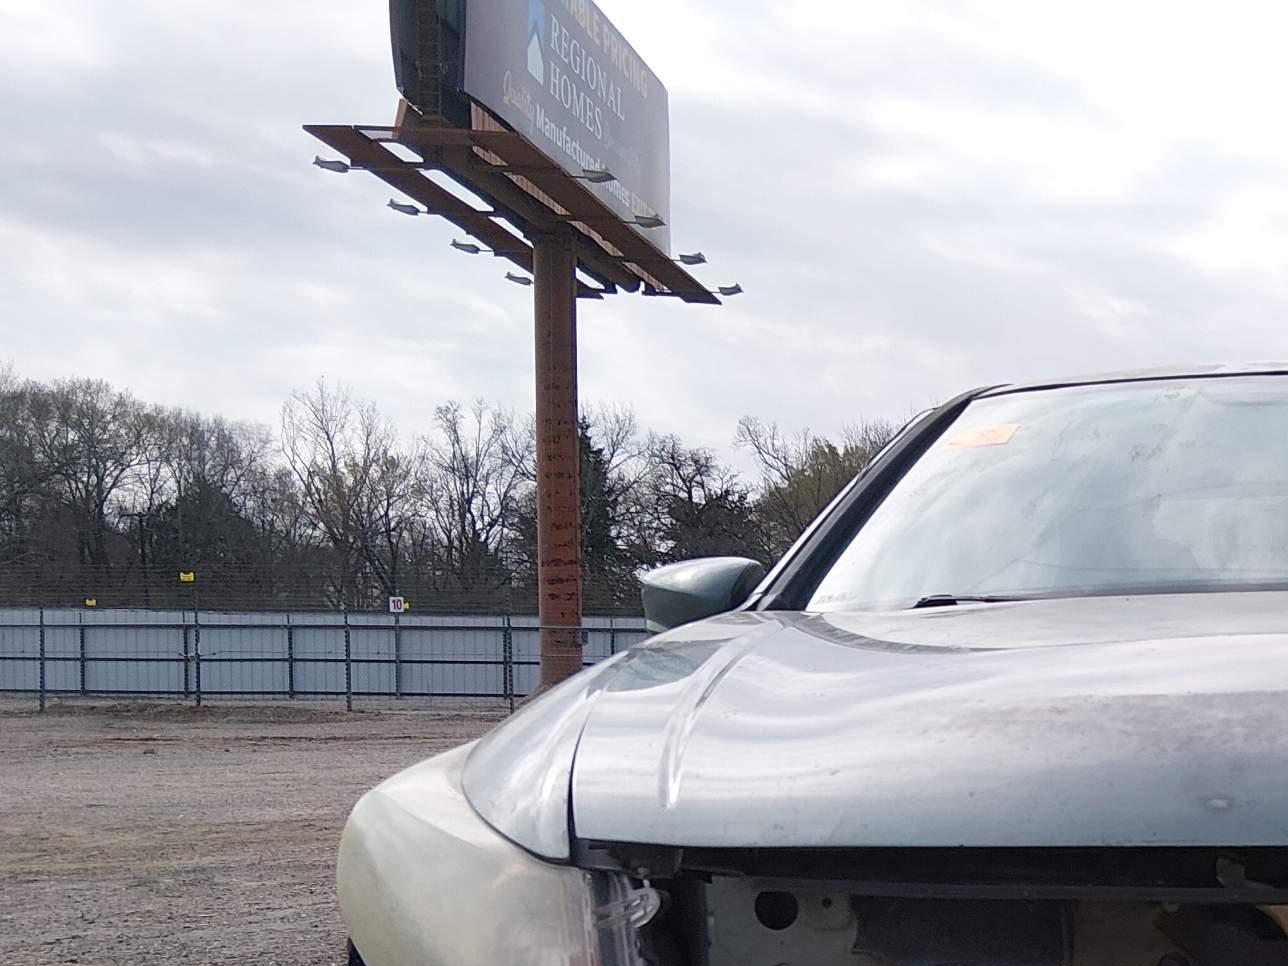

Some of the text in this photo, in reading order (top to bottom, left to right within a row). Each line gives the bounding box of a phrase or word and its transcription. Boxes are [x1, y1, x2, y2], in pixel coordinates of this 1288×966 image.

[550, 13, 625, 121] REGIONAL
[602, 23, 648, 99] PRICING
[536, 103, 601, 170] Manufactured
[550, 60, 602, 140] HOMES
[392, 599, 402, 610] 10
